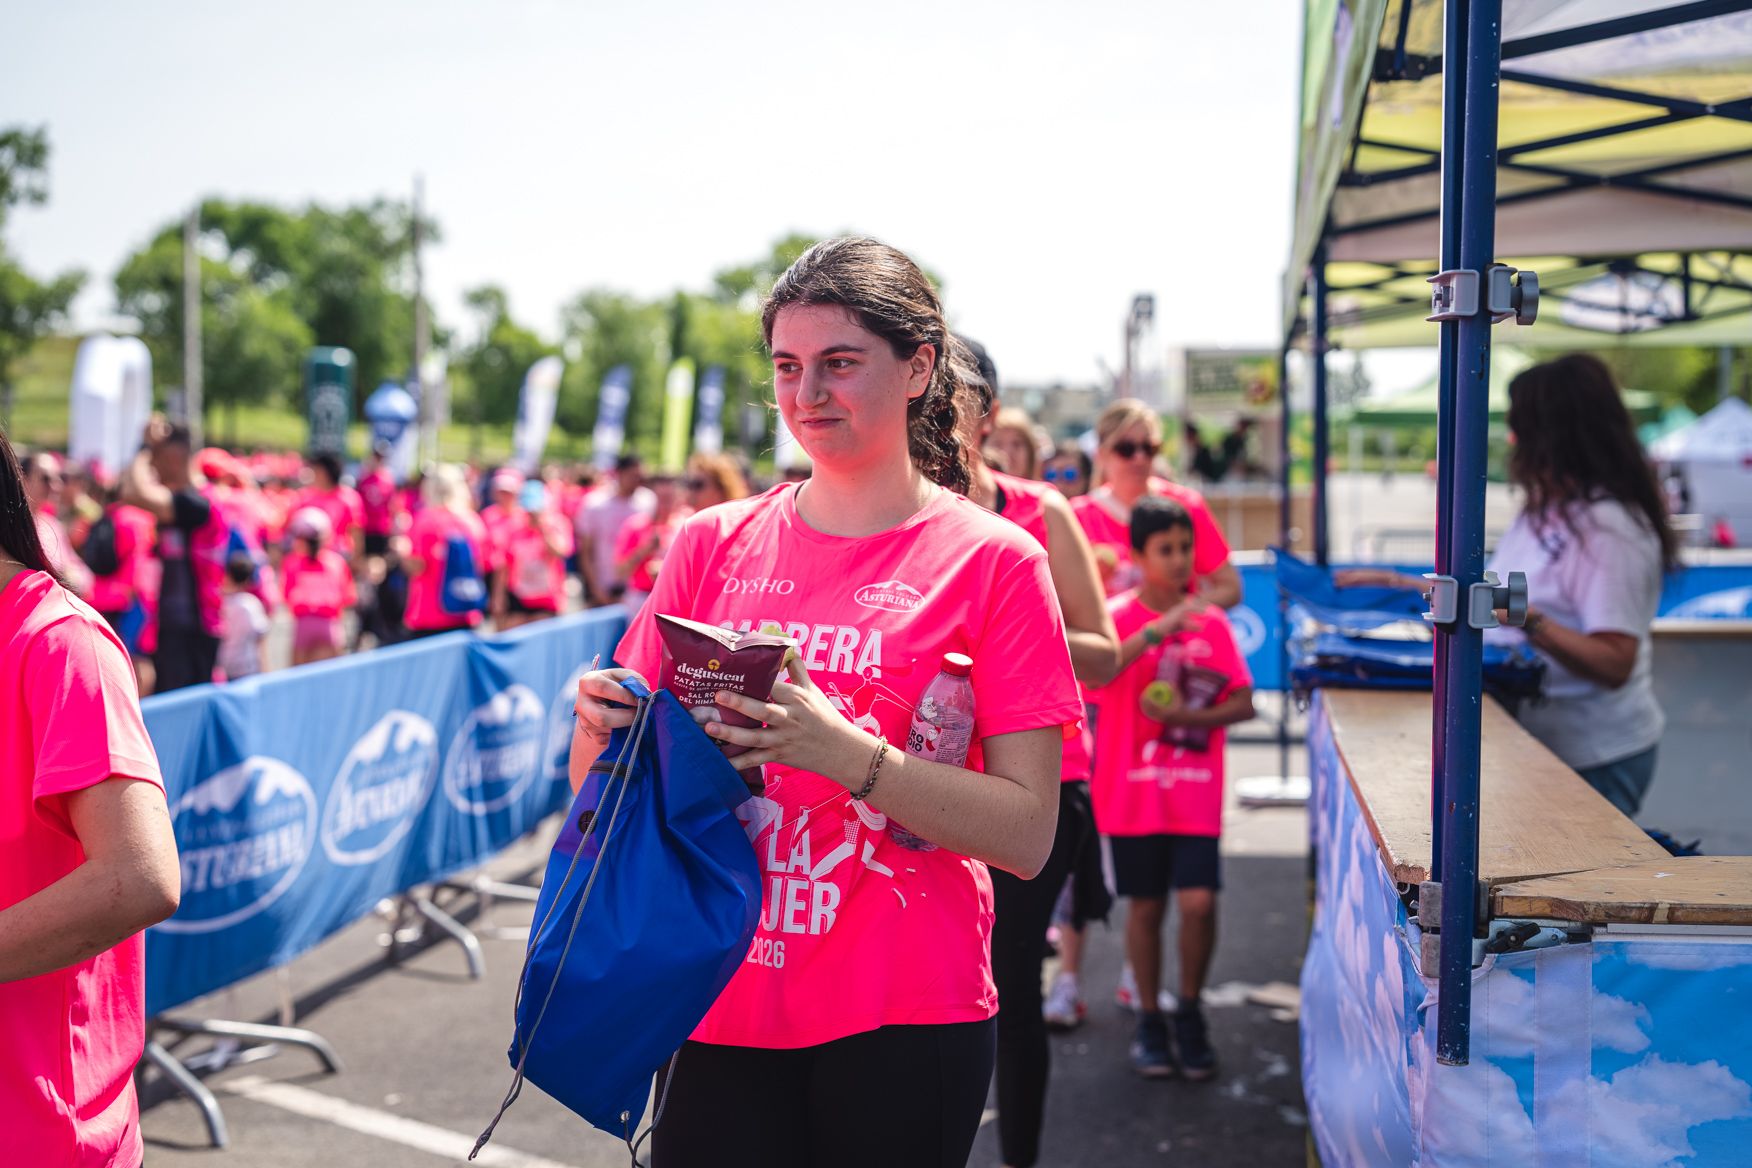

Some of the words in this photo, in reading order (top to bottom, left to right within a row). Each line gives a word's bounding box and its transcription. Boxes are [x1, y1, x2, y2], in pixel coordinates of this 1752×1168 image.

[723, 577, 795, 595] OYSHO
[859, 590, 921, 608] ASTURIANA
[677, 663, 745, 682] degusteat
[674, 675, 711, 687] PATATAS
[713, 682, 744, 691] FRITAS
[679, 696, 692, 704] DEL
[758, 876, 841, 935] JER
[747, 936, 785, 969] 2026
